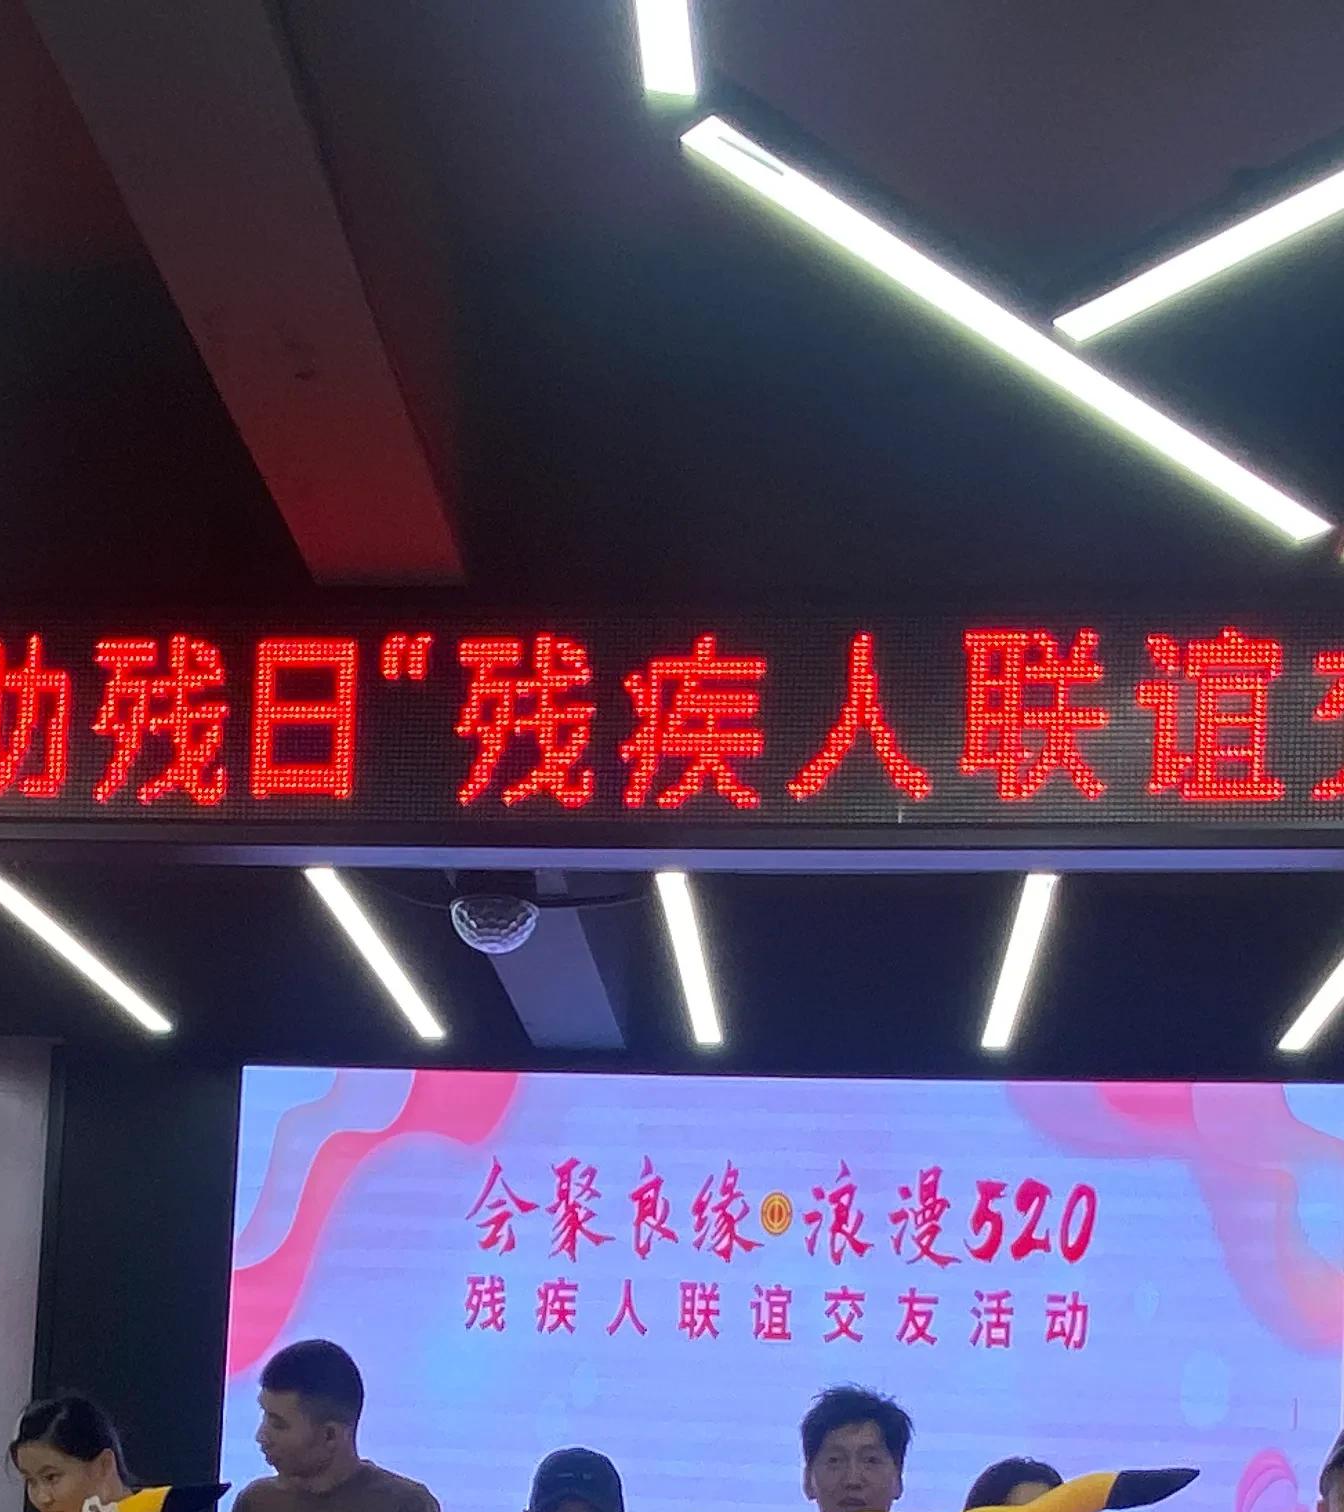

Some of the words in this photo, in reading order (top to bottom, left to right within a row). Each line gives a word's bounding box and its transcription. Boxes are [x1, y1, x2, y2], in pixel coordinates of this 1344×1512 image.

[463, 1275, 1091, 1350] 残疾人联谊交友活动
